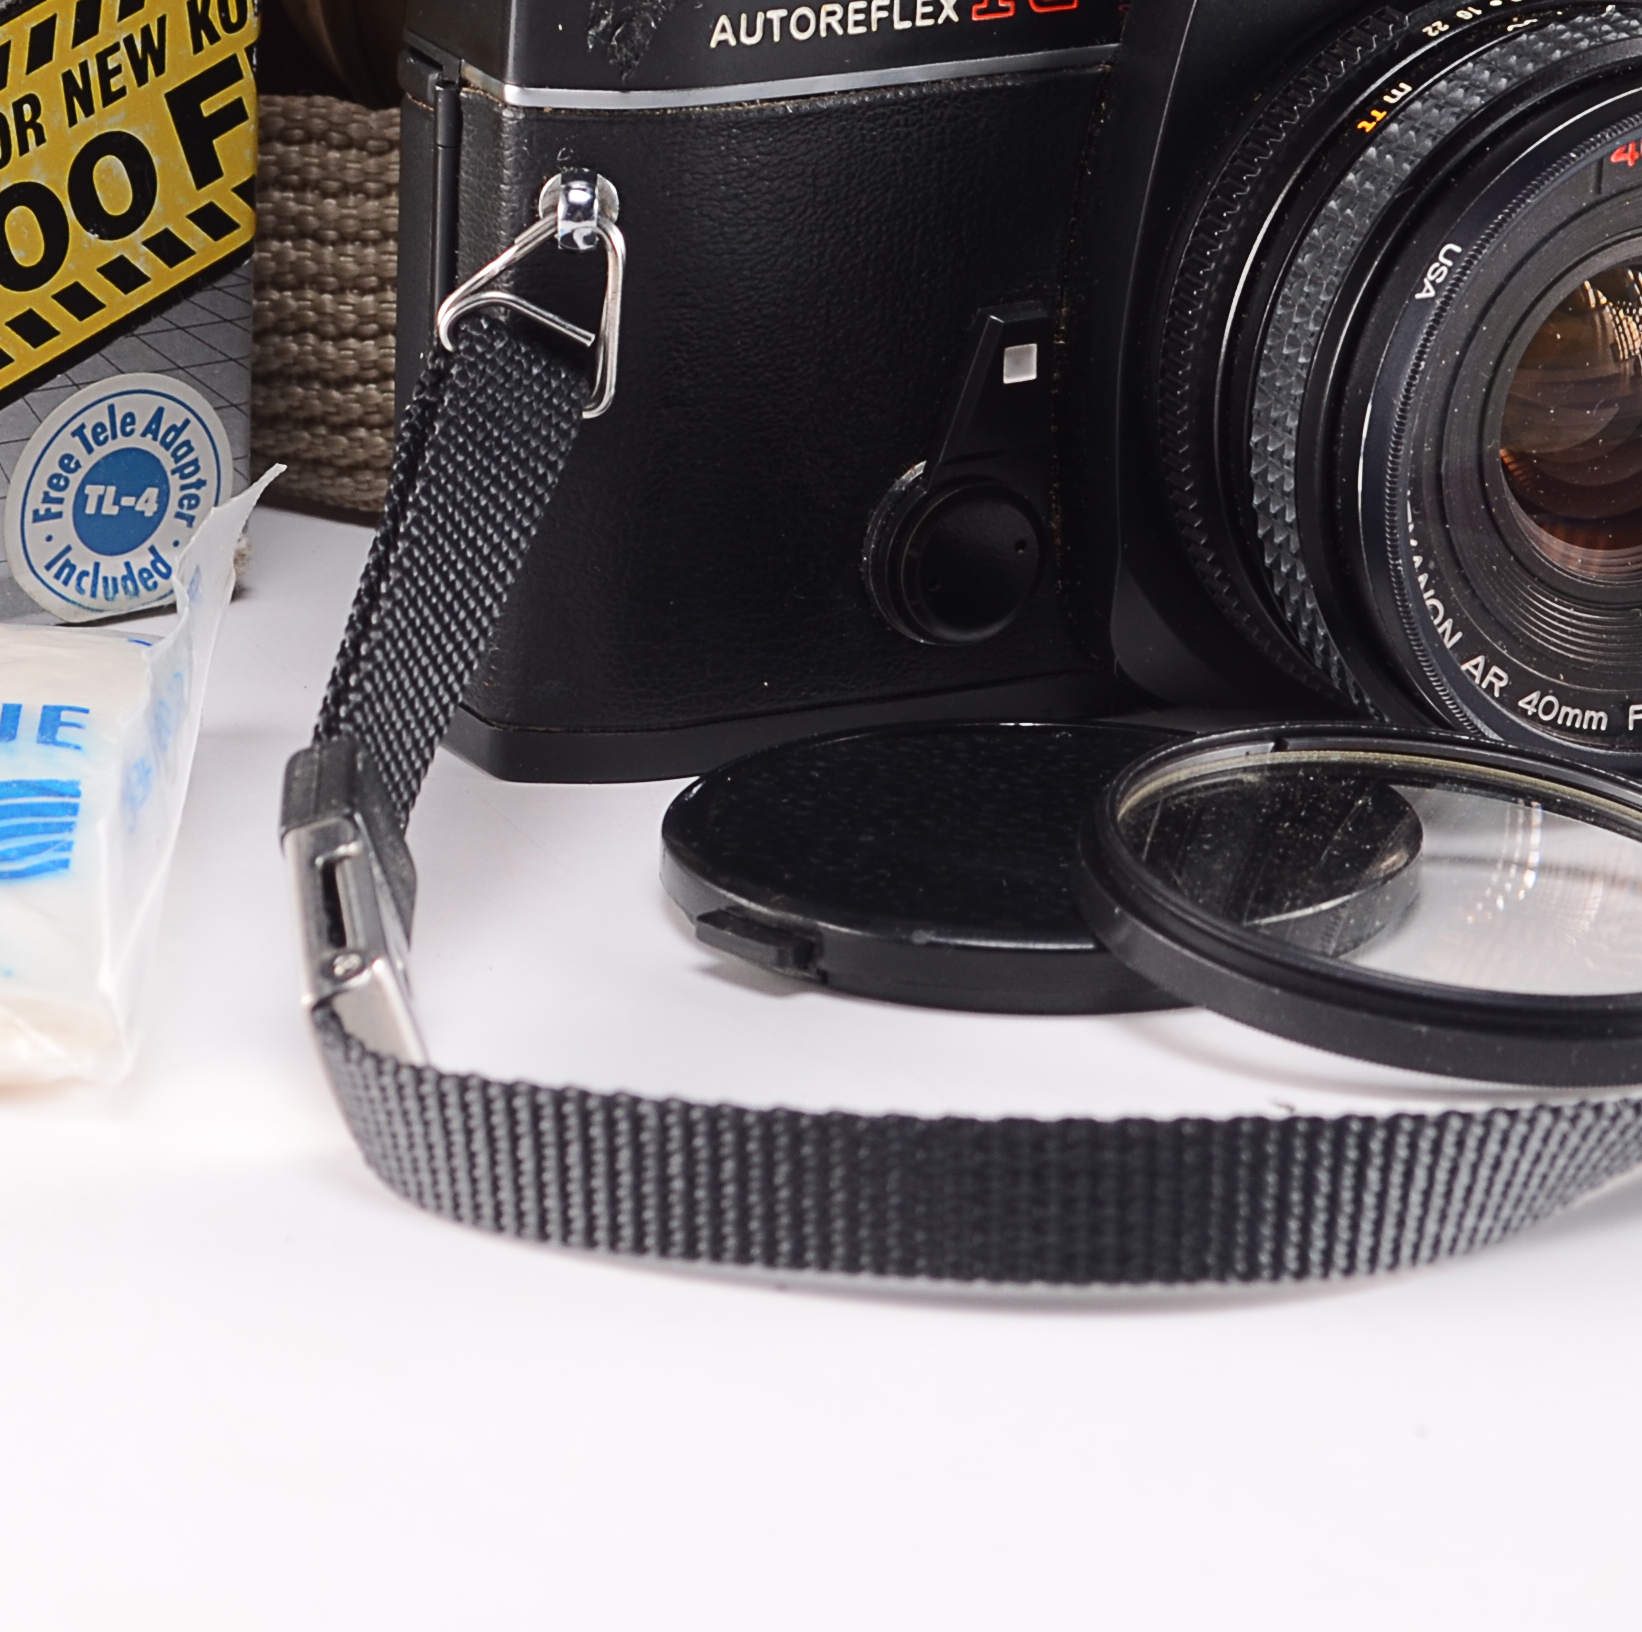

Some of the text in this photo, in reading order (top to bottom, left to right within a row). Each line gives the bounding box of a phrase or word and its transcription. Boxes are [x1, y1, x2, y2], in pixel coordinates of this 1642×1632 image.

[1421, 20, 1450, 37] 22
[61, 14, 168, 129] NEW
[163, 46, 254, 192] F
[1414, 243, 1462, 300] USA
[31, 403, 207, 529] Free Tele Adapter
[83, 484, 160, 518] TL-4
[44, 544, 173, 602] Included
[1460, 654, 1510, 698] AR
[1517, 688, 1609, 732] 40mm
